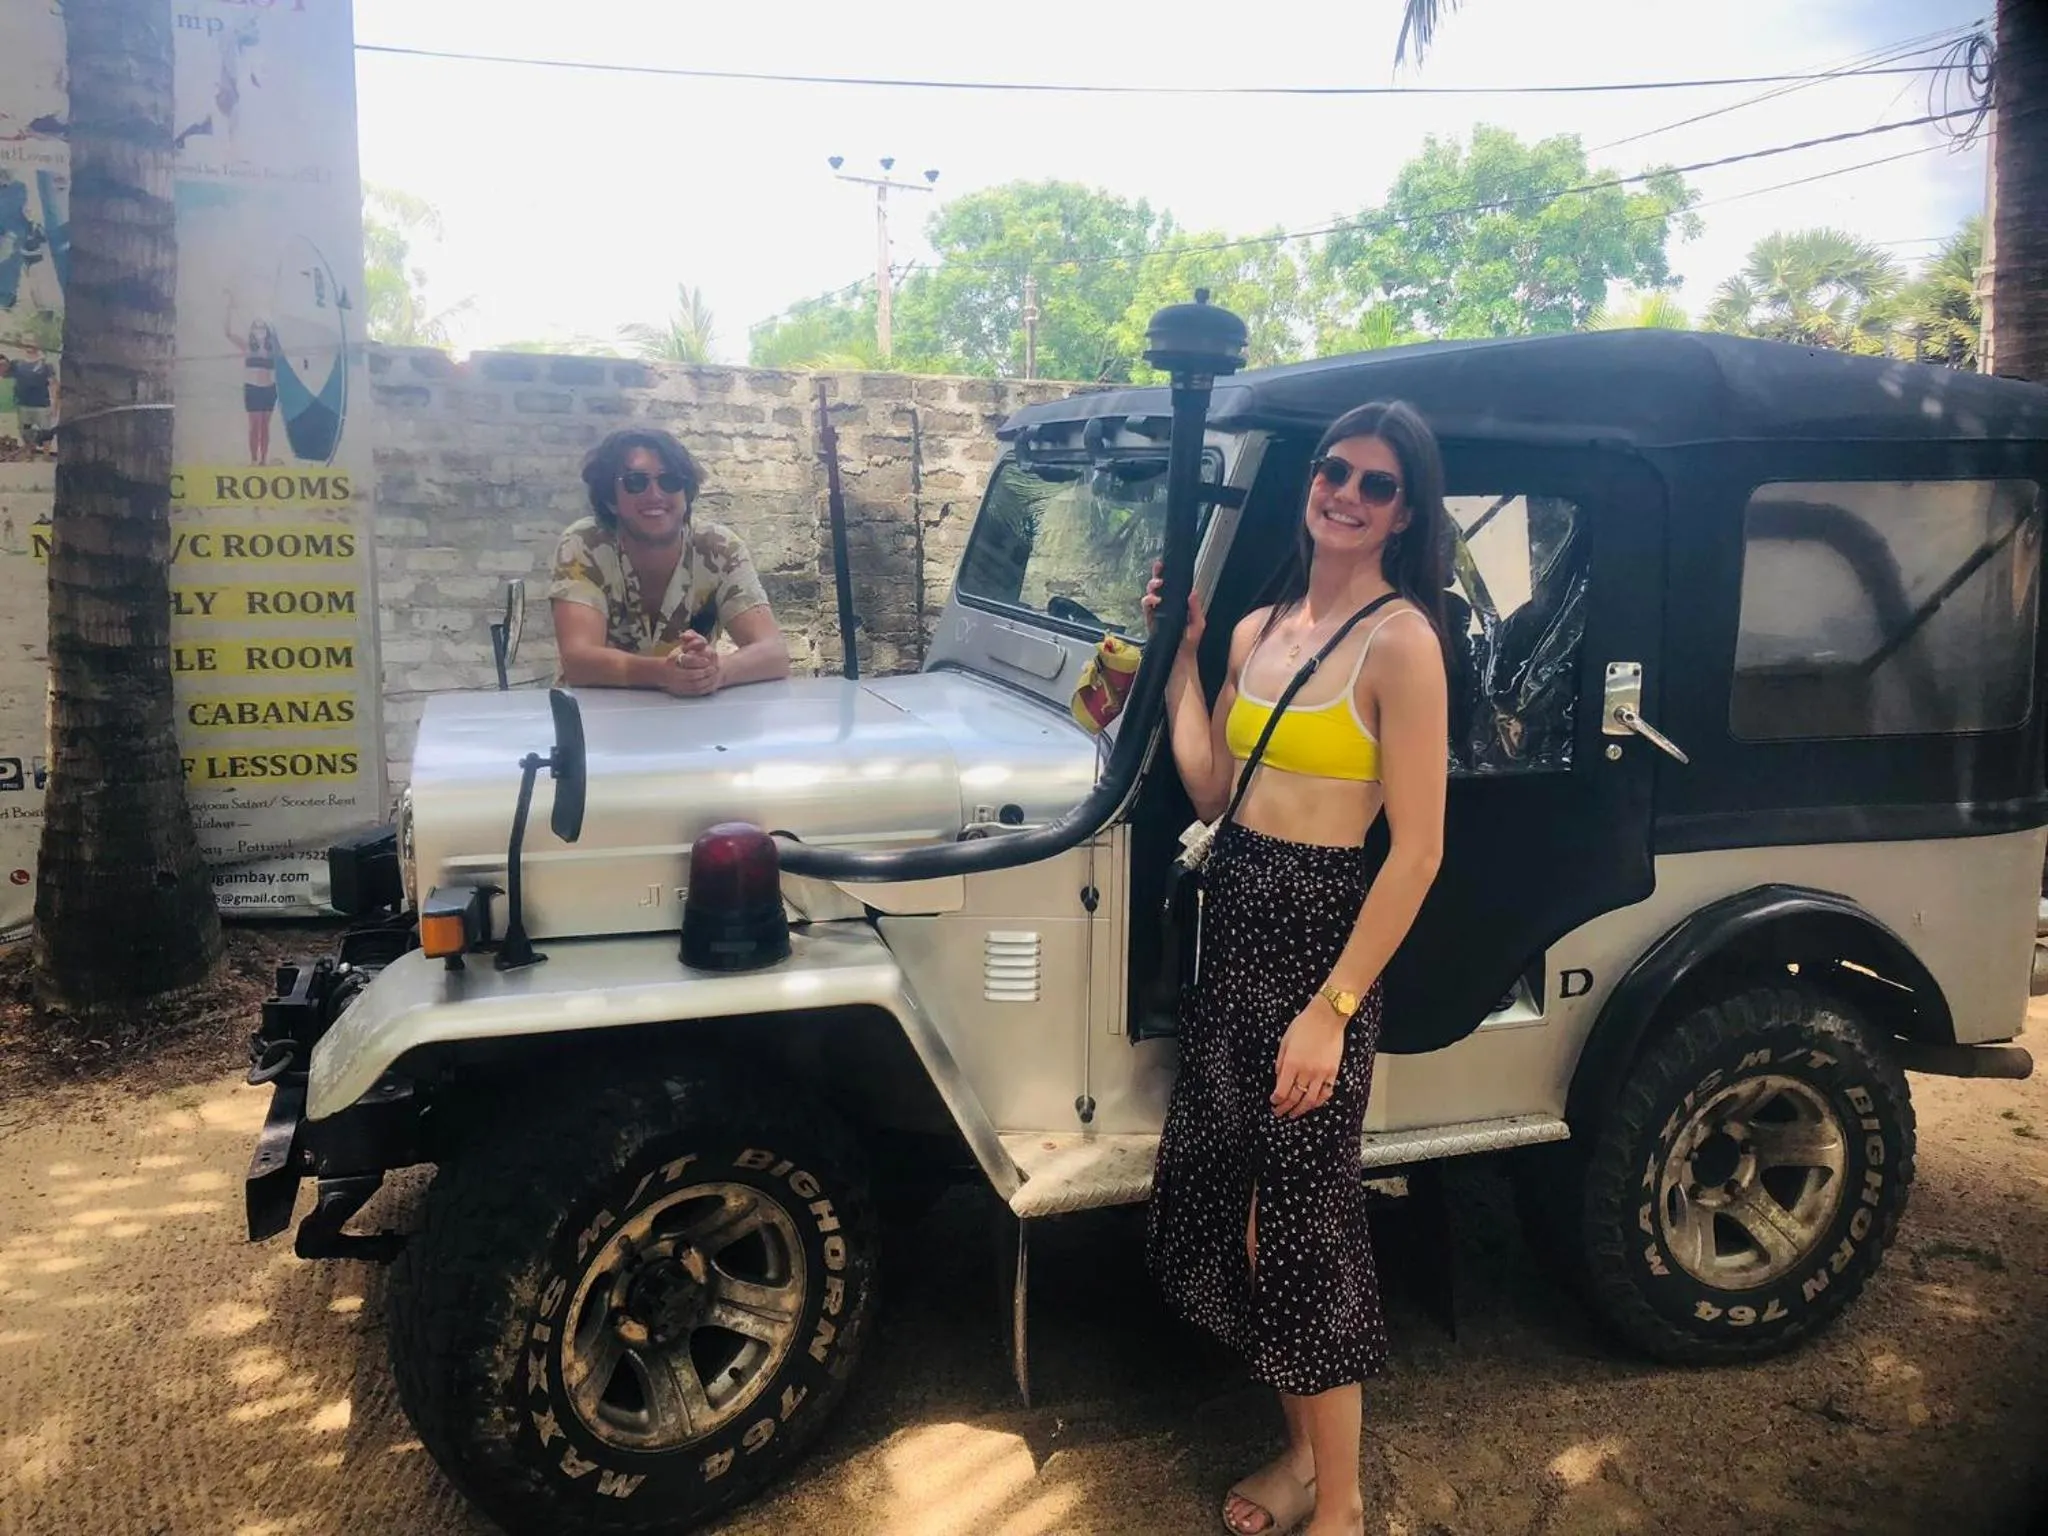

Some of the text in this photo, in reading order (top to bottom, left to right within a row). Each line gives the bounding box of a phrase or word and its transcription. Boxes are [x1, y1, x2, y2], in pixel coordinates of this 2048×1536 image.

[177, 13, 225, 37] mp
[169, 475, 350, 500] C ROOMS
[171, 534, 212, 563] /C
[223, 534, 355, 558] ROOMS
[171, 590, 356, 615] LY ROOM
[174, 646, 354, 672] LE ROOM
[188, 700, 355, 725] CABANAS
[181, 753, 358, 780] F LESSONS
[211, 870, 309, 886] gambay.com
[214, 892, 295, 905] 5@gmail.com
[1558, 967, 1594, 999] D
[1638, 1068, 1724, 1276] MAXXIS
[1802, 1086, 1886, 1303] BIGHORN
[732, 1147, 849, 1365] BIGHORN
[1694, 1298, 1789, 1327] 764
[527, 1274, 648, 1499] MAXXIS
[702, 1384, 808, 1483] 764
